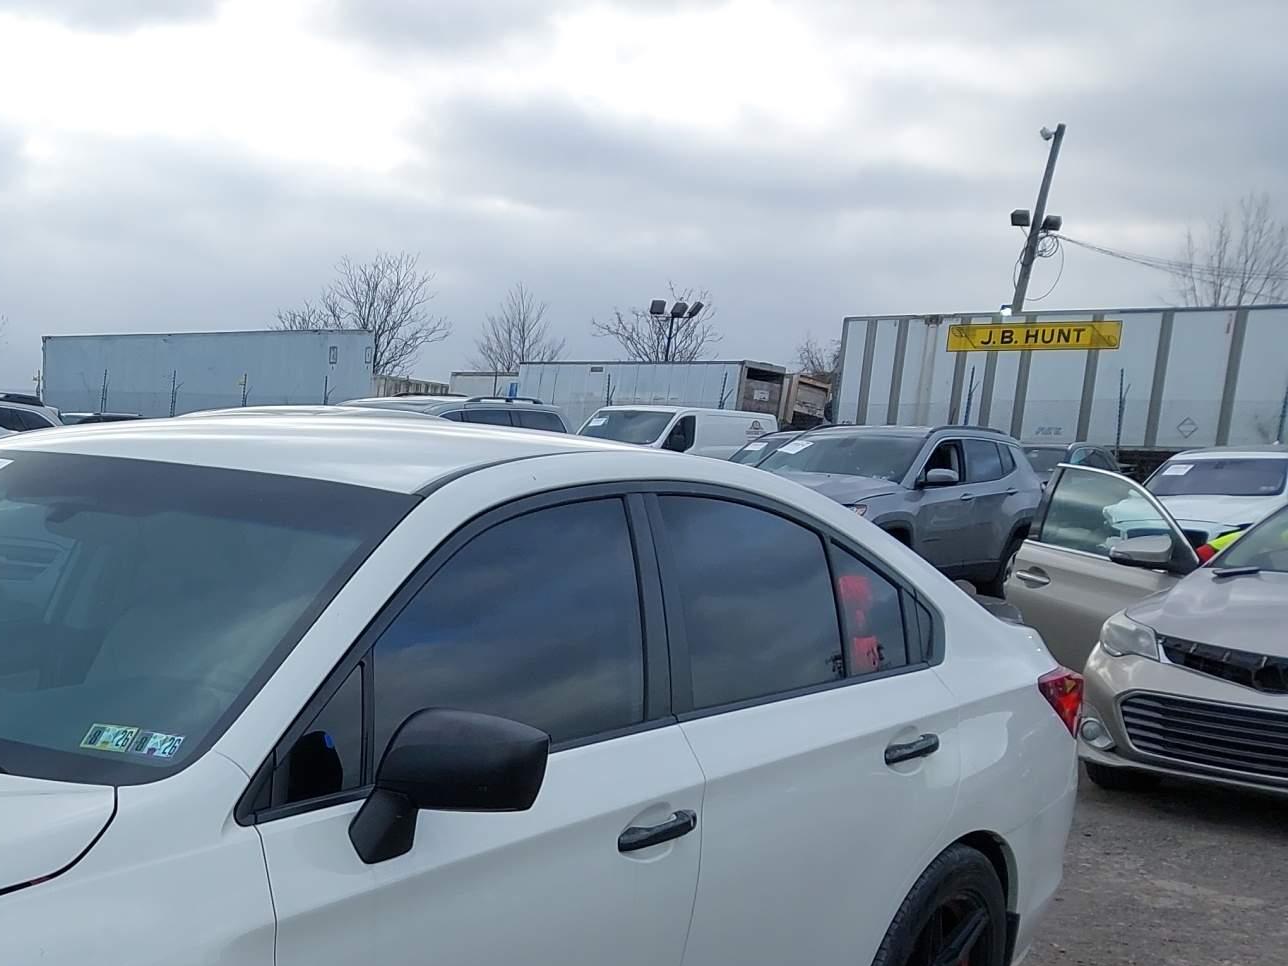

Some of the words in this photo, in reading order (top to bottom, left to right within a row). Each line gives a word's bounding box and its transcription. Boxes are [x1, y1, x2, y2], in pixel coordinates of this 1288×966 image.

[1024, 328, 1087, 344] HUNT
[115, 730, 134, 747] 26
[161, 736, 182, 756] 26
